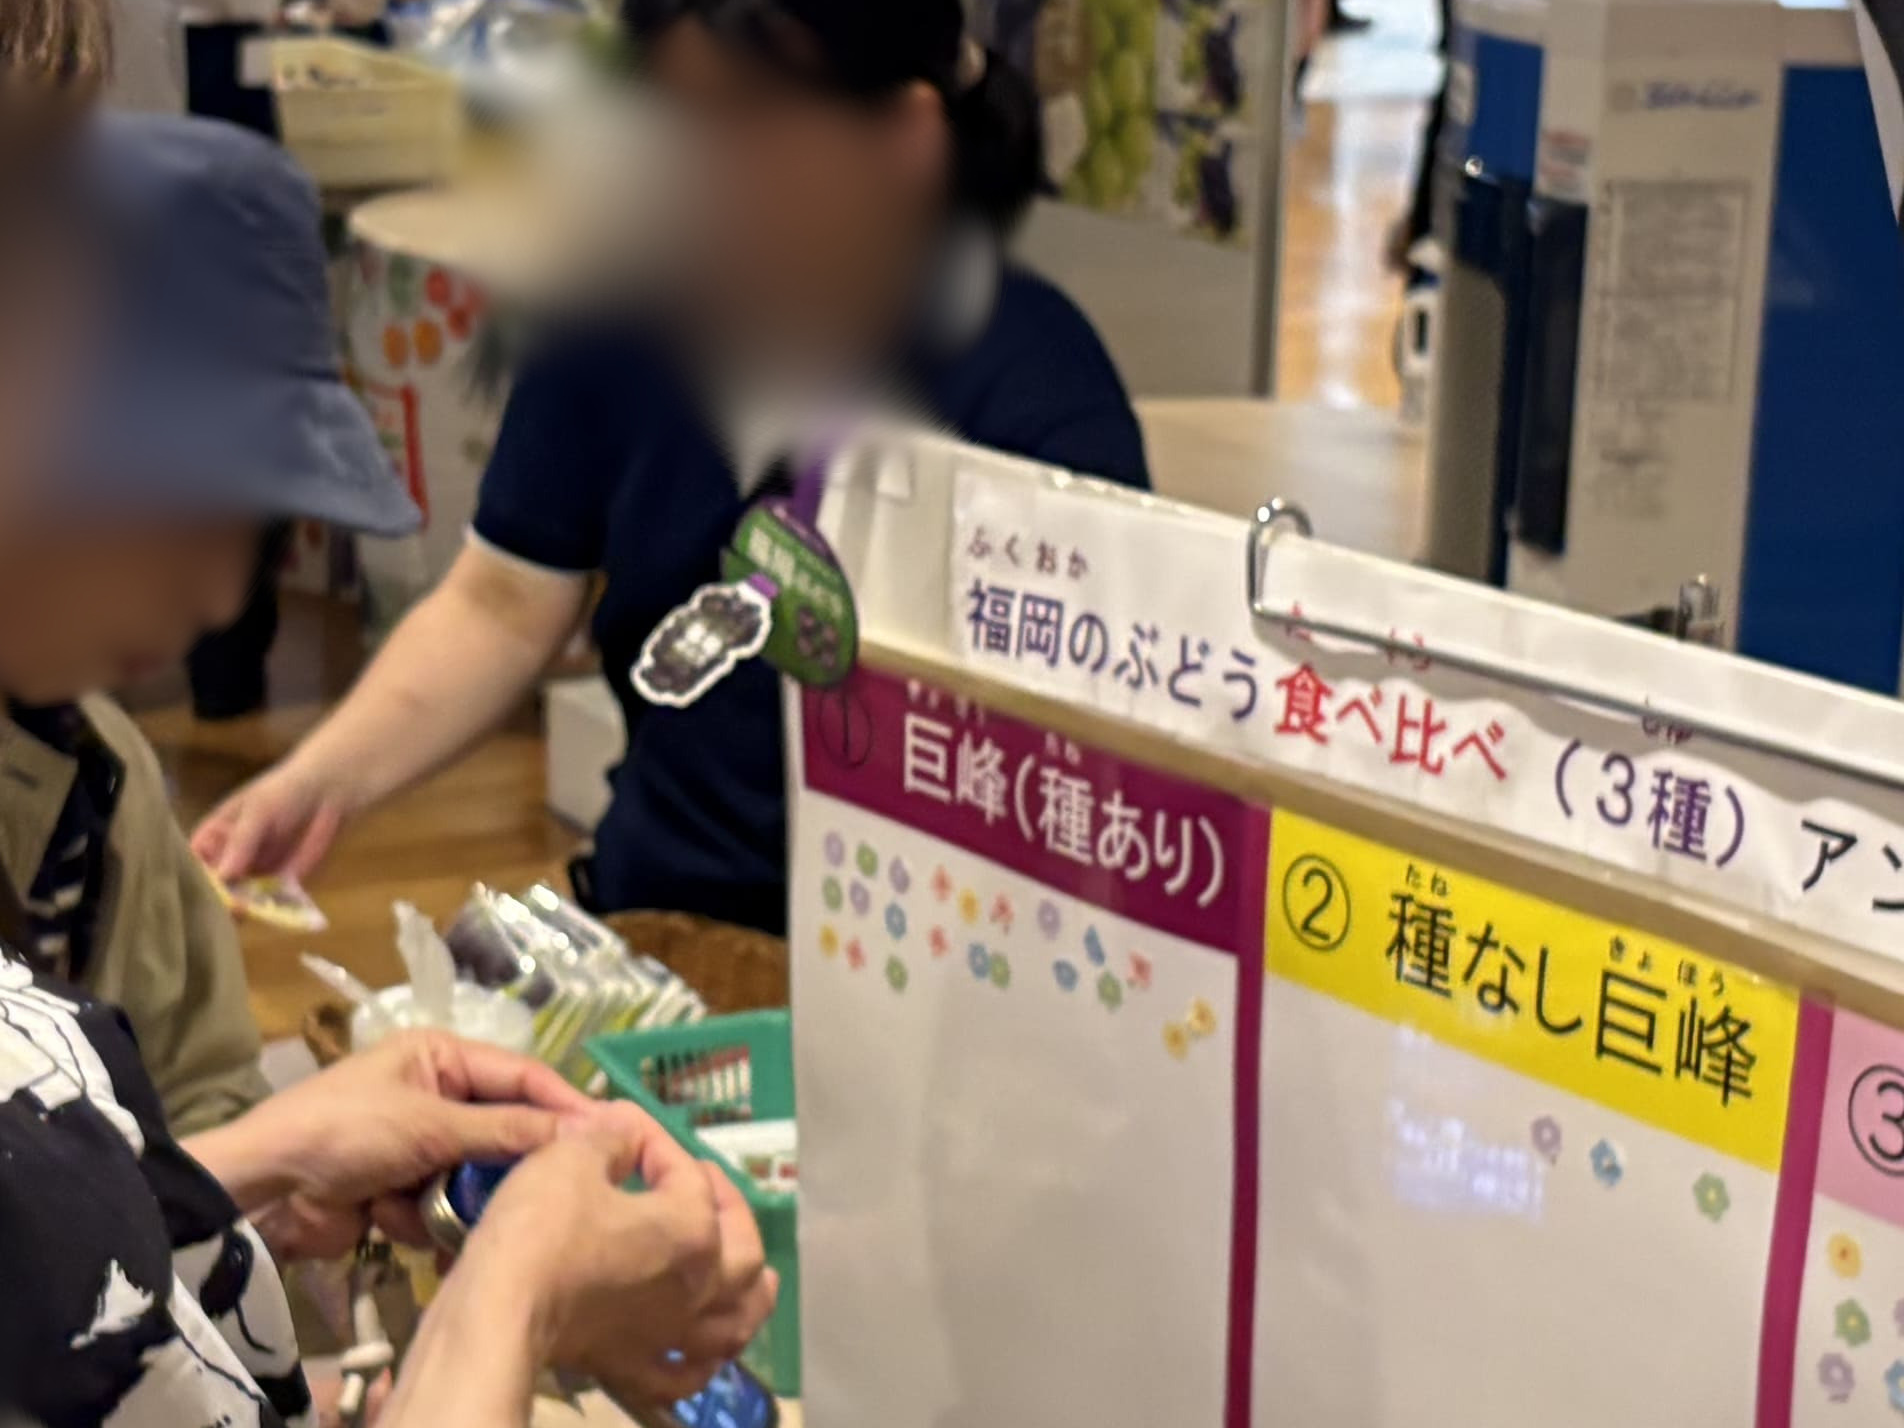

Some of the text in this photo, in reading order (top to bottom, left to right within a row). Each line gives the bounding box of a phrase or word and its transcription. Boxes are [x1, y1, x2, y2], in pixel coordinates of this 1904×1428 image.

[966, 528, 1090, 575] ふくおか
[1404, 863, 1448, 898] たね
[1384, 890, 1759, 1108] 種なし巨峰
